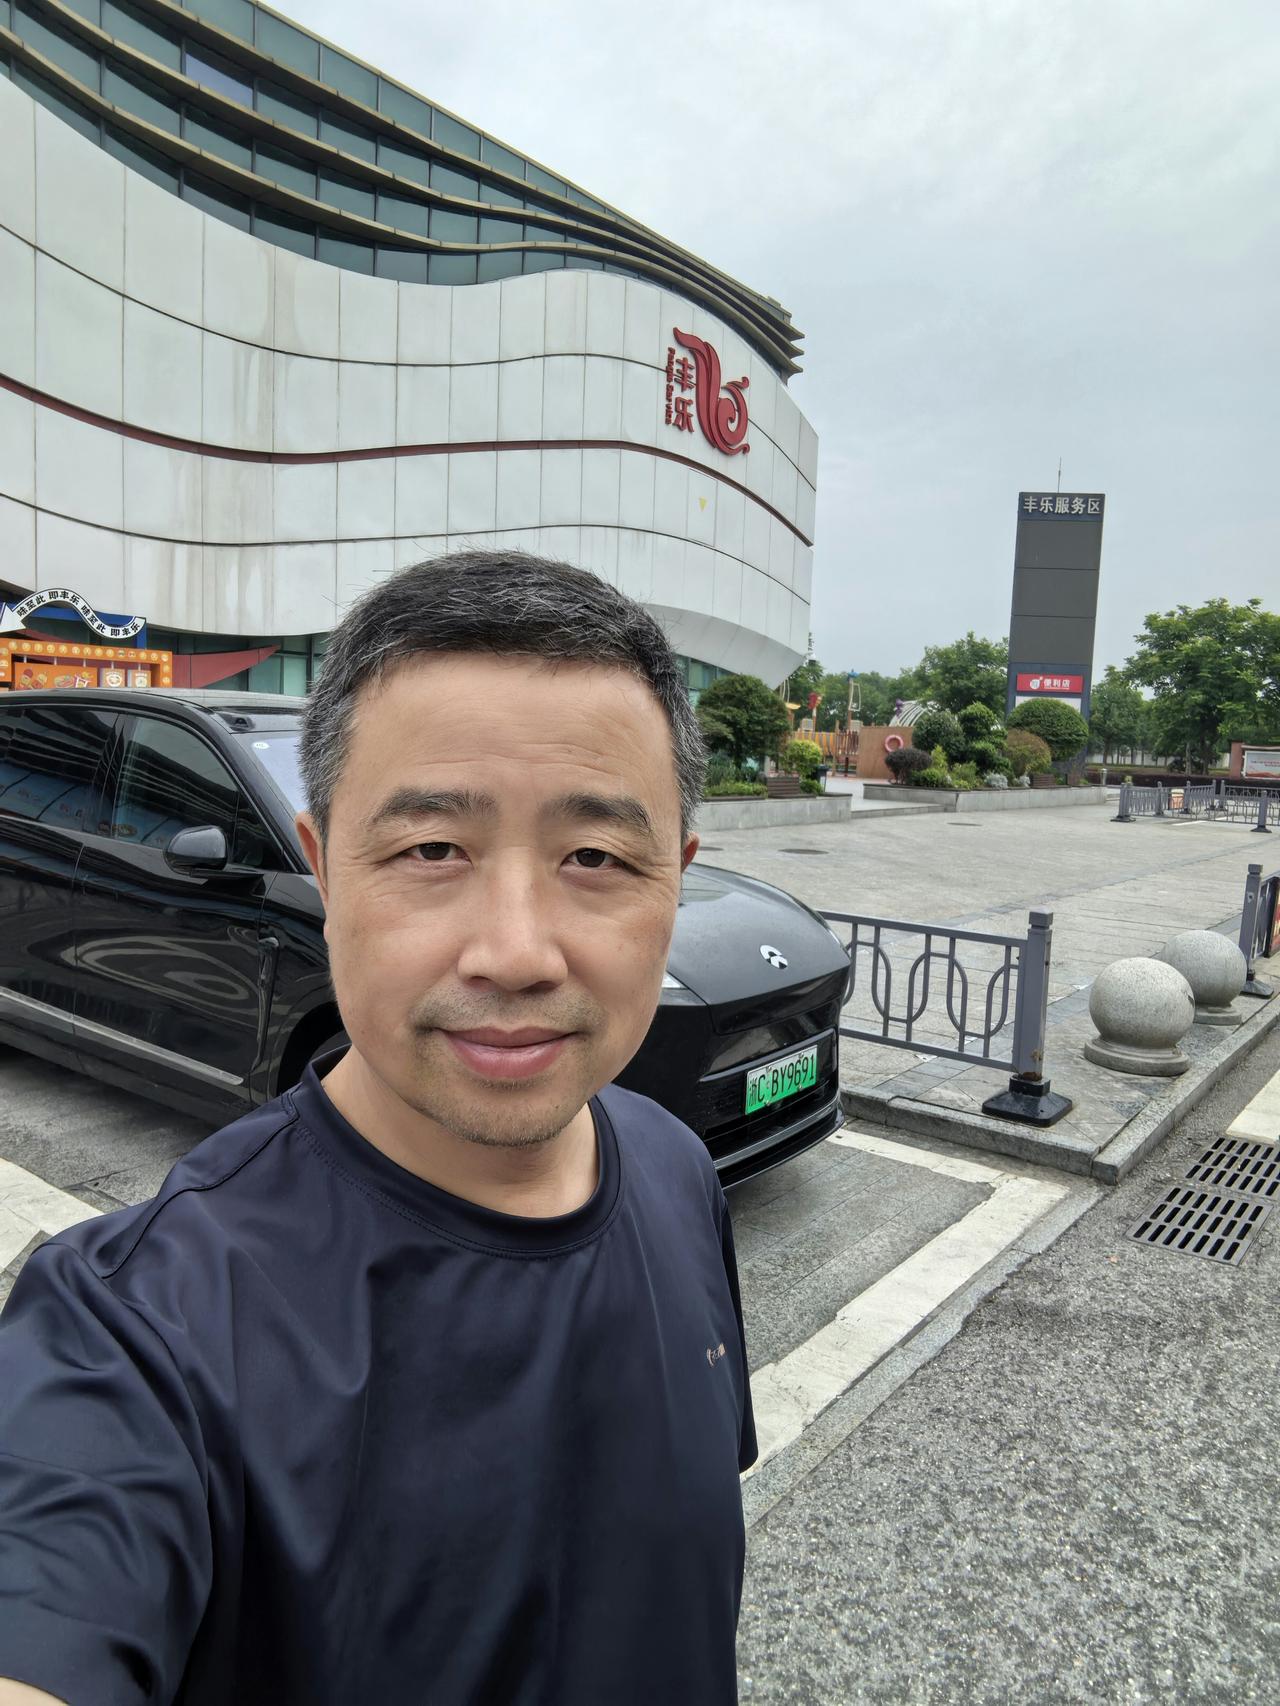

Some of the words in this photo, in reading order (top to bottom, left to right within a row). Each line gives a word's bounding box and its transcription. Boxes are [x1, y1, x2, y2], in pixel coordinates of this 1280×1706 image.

[674, 357, 696, 433] 丰乐
[1023, 496, 1101, 514] 丰乐服务区
[1043, 678, 1071, 688] 便利店
